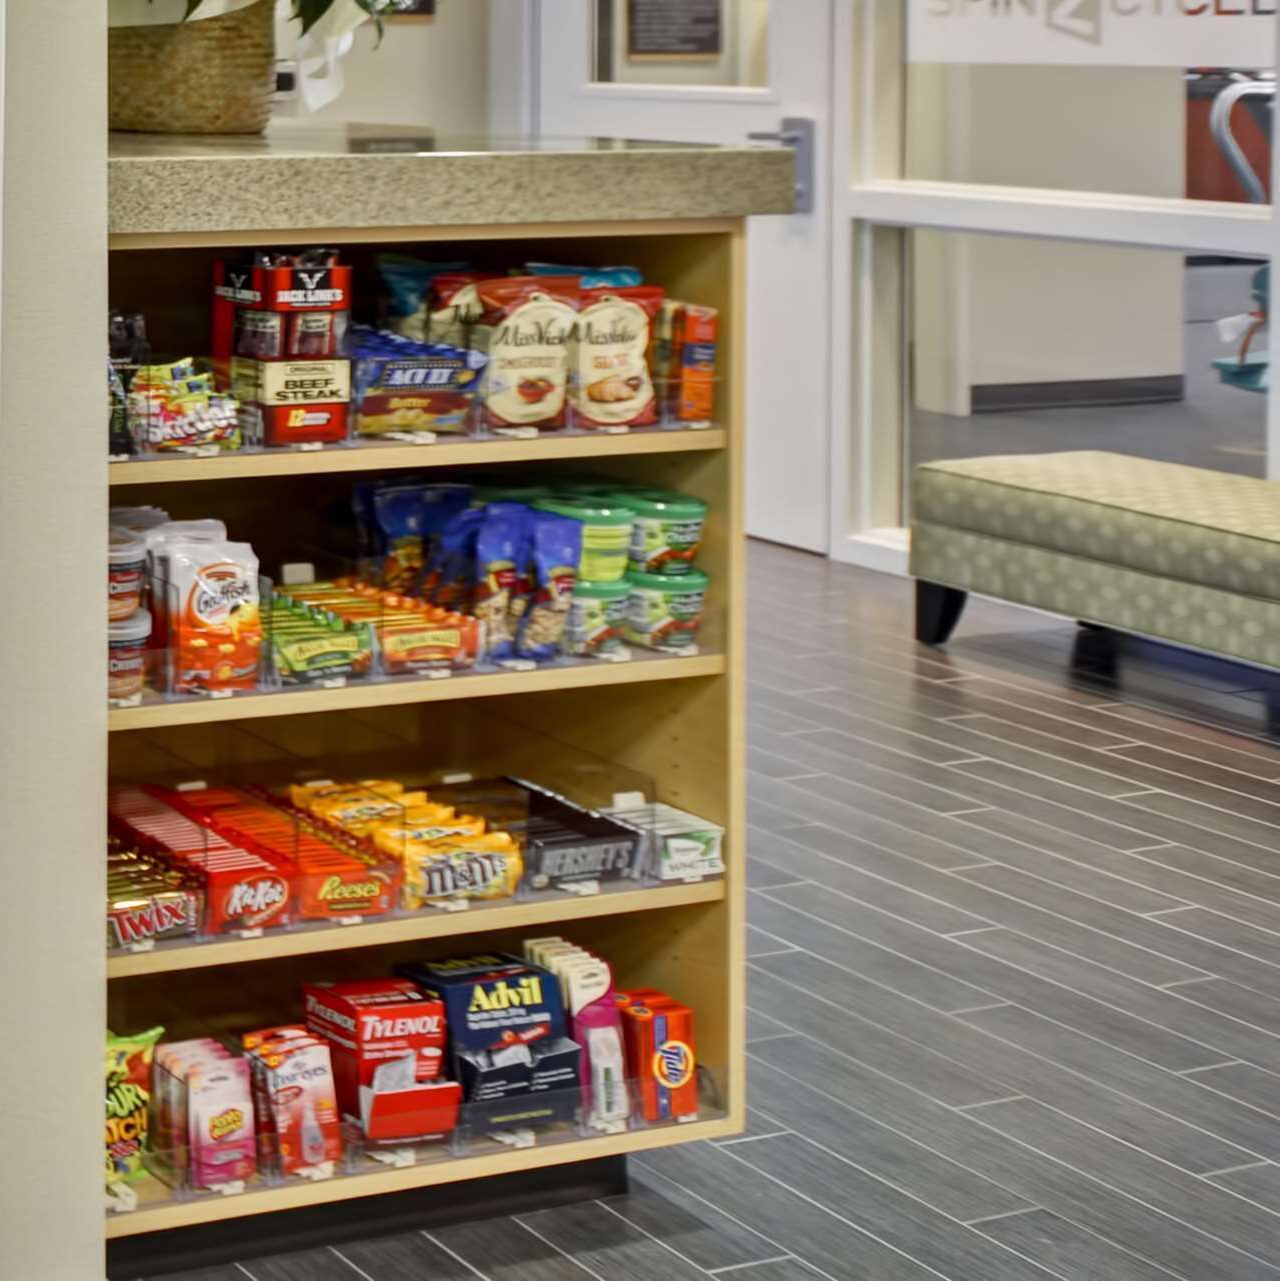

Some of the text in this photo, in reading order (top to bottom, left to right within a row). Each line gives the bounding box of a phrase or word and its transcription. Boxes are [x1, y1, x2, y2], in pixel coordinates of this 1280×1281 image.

[284, 379, 336, 390] BEEF
[276, 390, 344, 401] STEAK
[668, 858, 720, 873] WHITE
[468, 976, 543, 1012] Advil
[362, 1015, 441, 1041] TYLENOL
